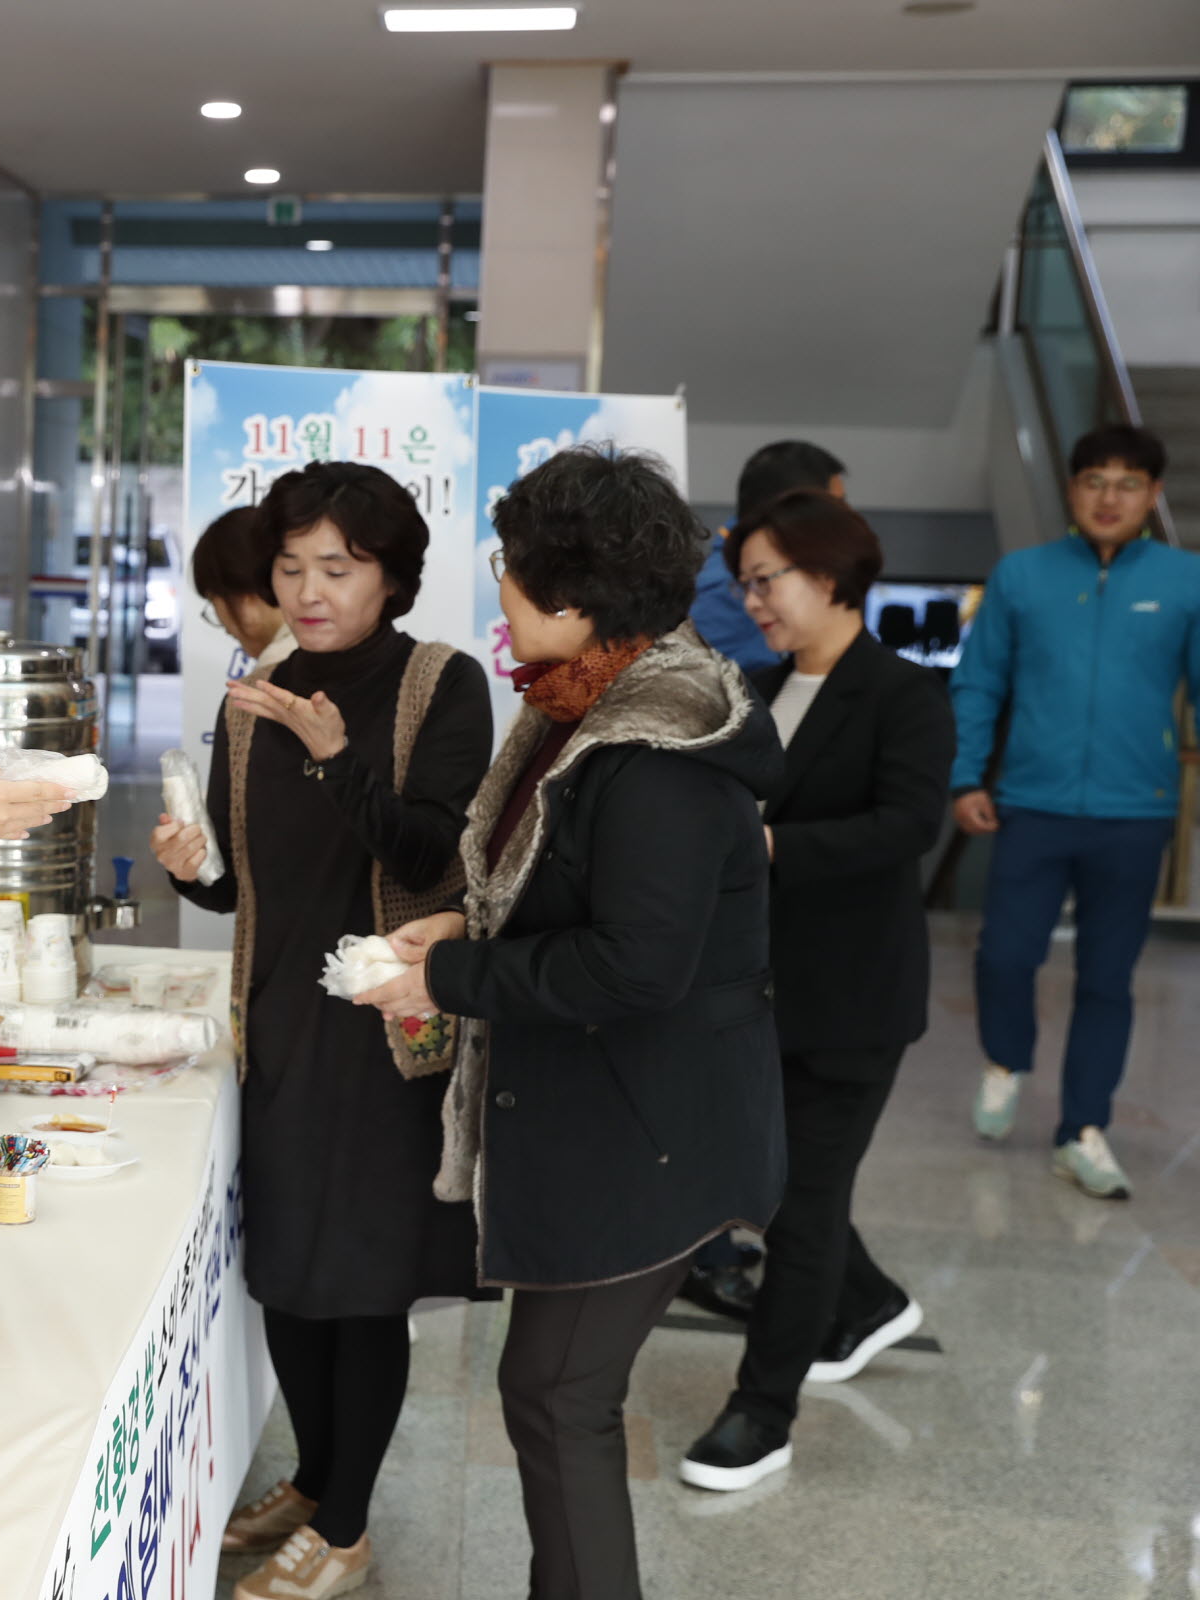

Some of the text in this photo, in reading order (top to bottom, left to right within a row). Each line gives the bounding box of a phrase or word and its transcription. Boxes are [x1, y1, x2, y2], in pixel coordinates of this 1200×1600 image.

[251, 419, 332, 462] 11월
[90, 1369, 140, 1561] 친환경
[143, 1330, 156, 1433] 쌀
